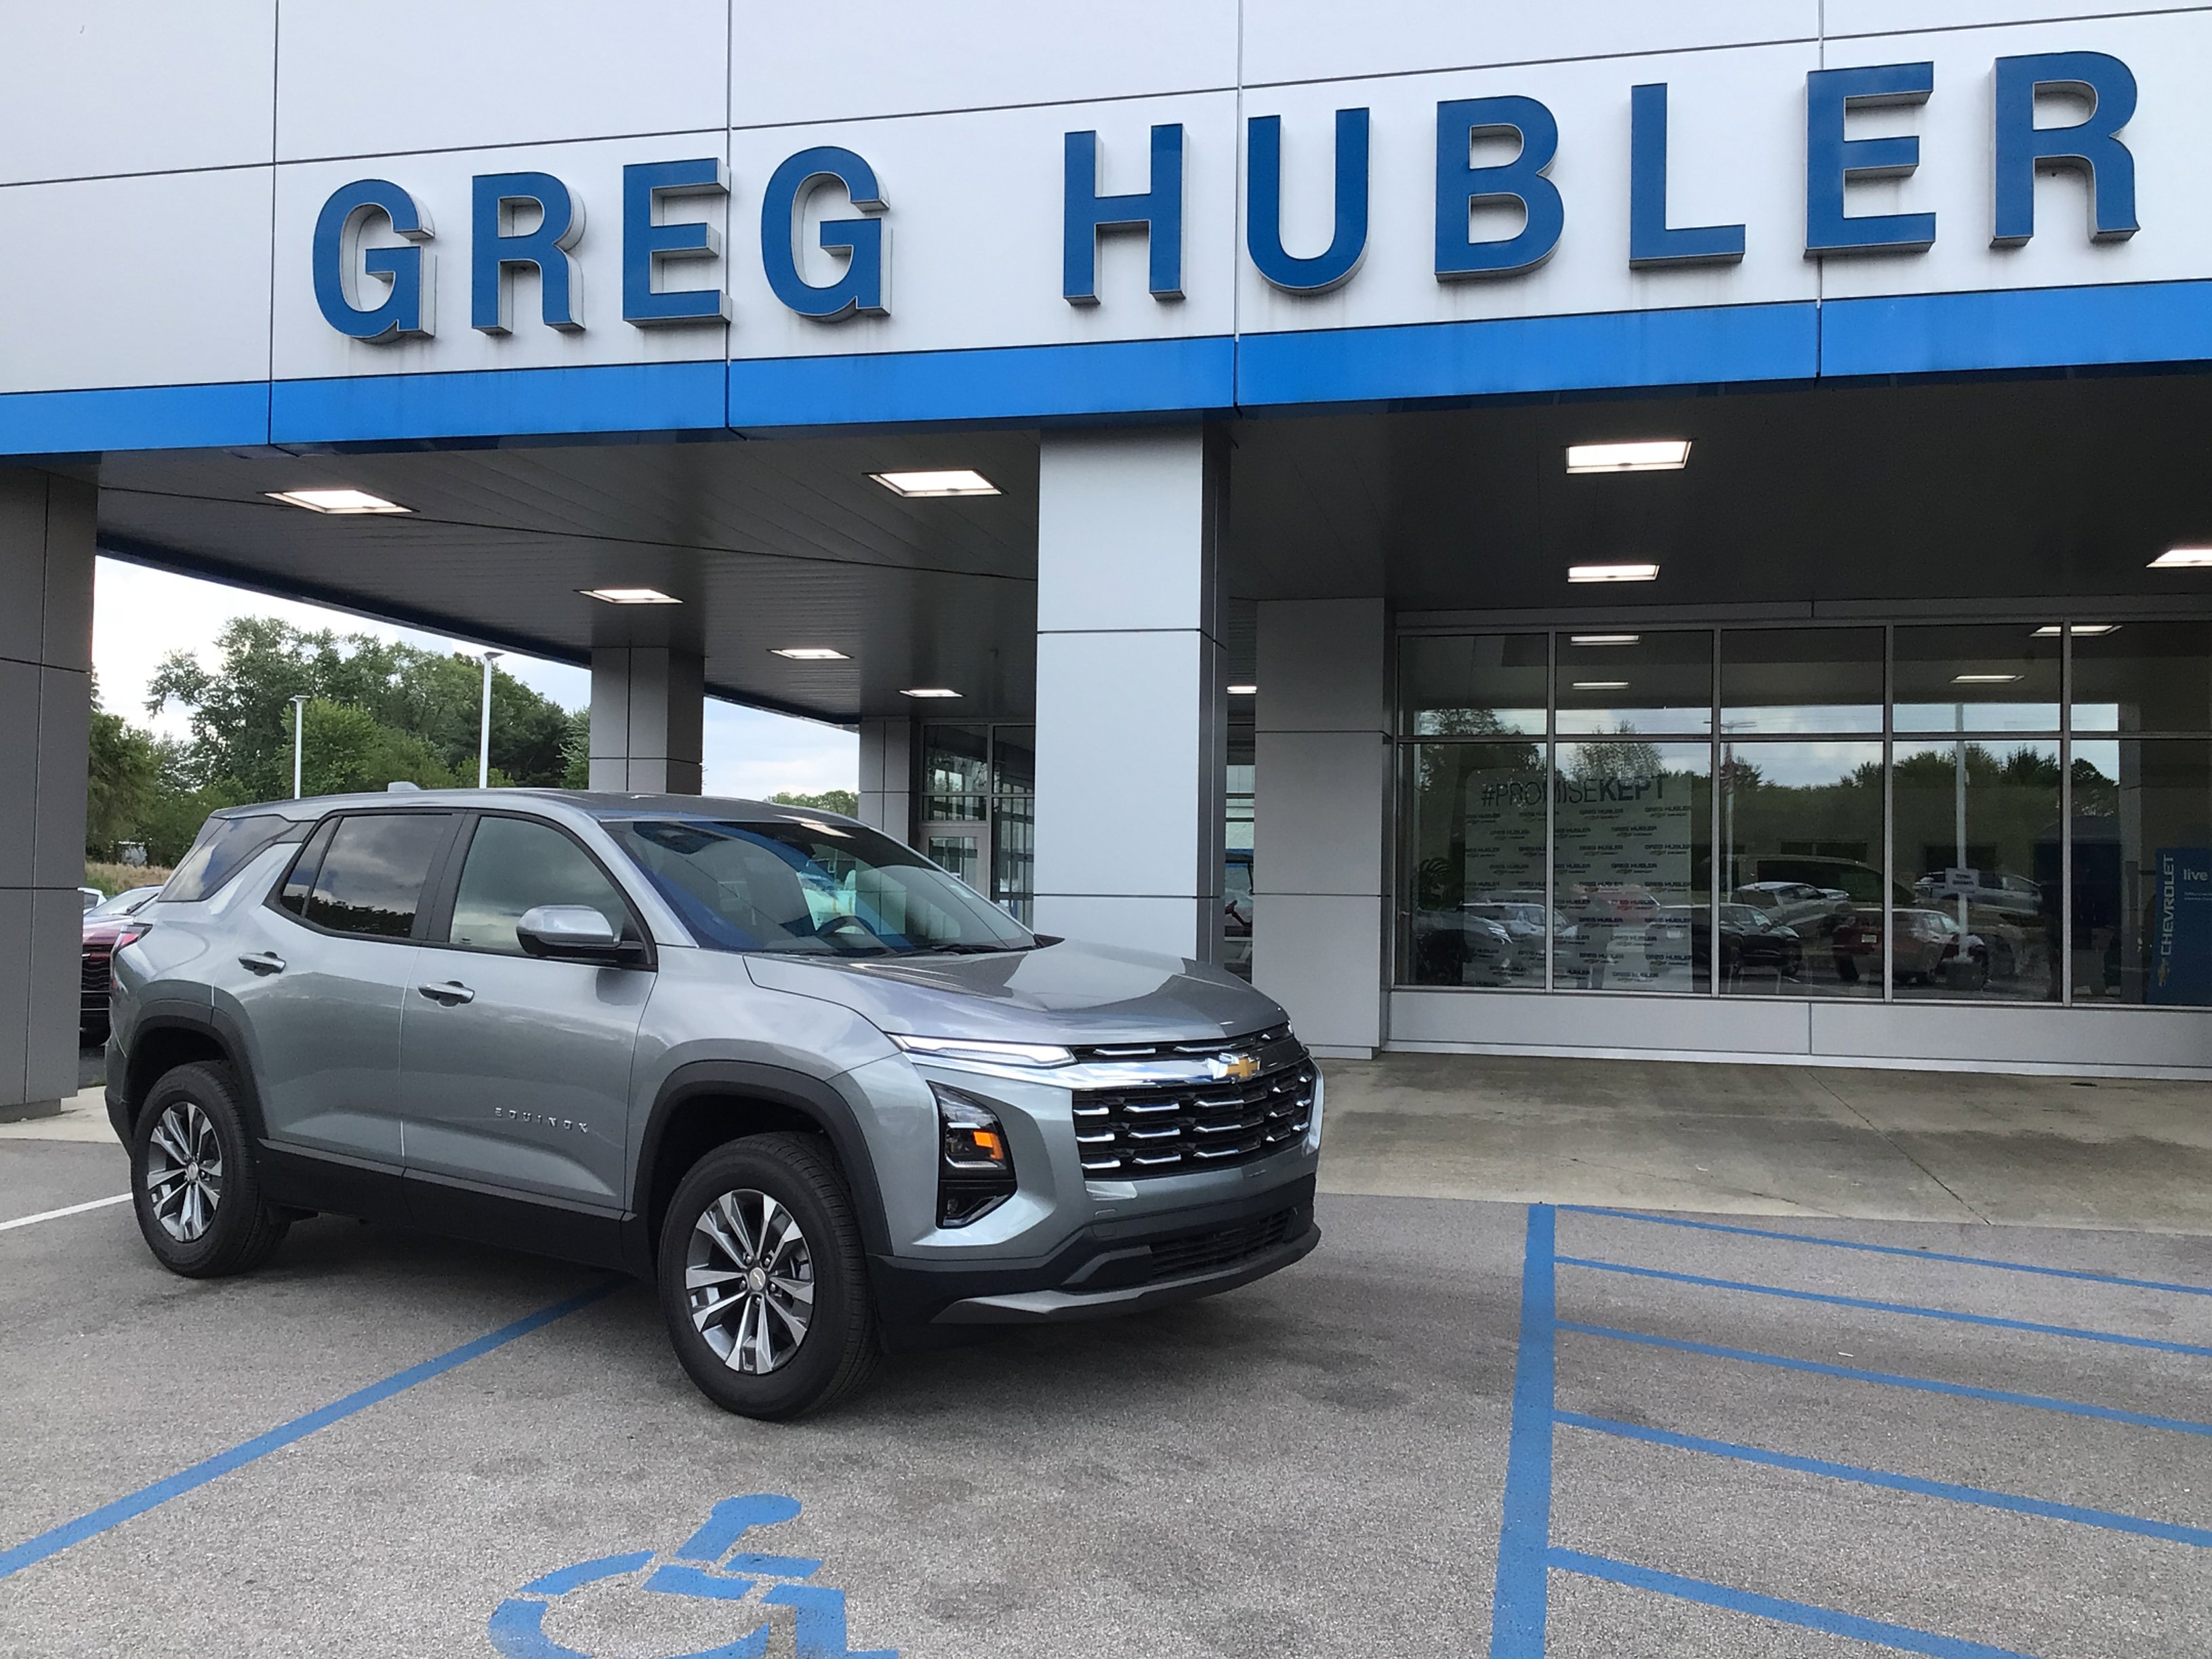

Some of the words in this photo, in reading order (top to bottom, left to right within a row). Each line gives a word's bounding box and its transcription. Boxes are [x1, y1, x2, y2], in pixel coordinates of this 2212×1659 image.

[312, 145, 890, 342] GREG
[1063, 50, 2139, 304] HUBLER
[2160, 854, 2174, 956] CHEVROLET
[2184, 868, 2209, 882] live
[494, 1107, 589, 1134] EQUINOX
